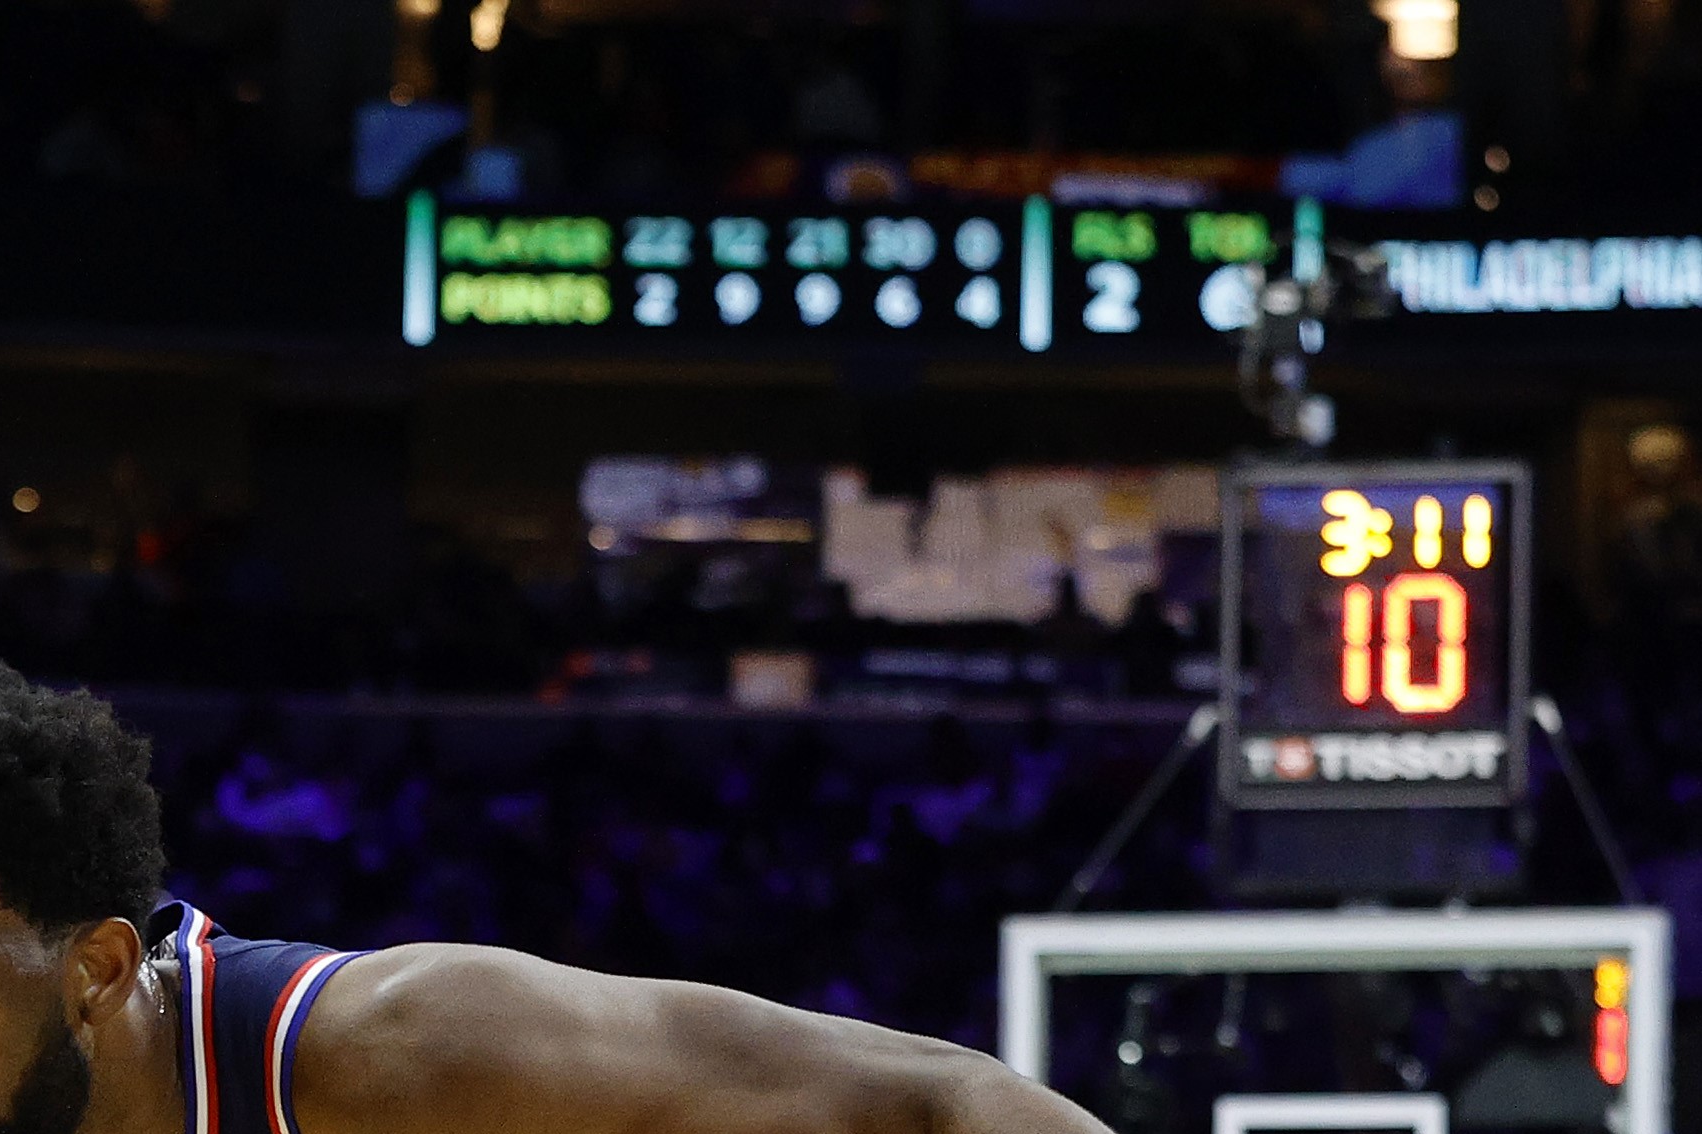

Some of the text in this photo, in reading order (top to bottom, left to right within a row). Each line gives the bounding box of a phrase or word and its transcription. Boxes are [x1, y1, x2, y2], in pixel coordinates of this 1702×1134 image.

[441, 215, 612, 266] PLAYER
[623, 216, 695, 268] 22
[786, 216, 851, 268] 21
[441, 271, 1002, 329] POINTS 2 9 9 6 4
[1082, 260, 1142, 332] 2
[1320, 489, 1493, 577] 3:11
[1342, 573, 1468, 714] 10
[1314, 732, 1506, 781] TISSOT
